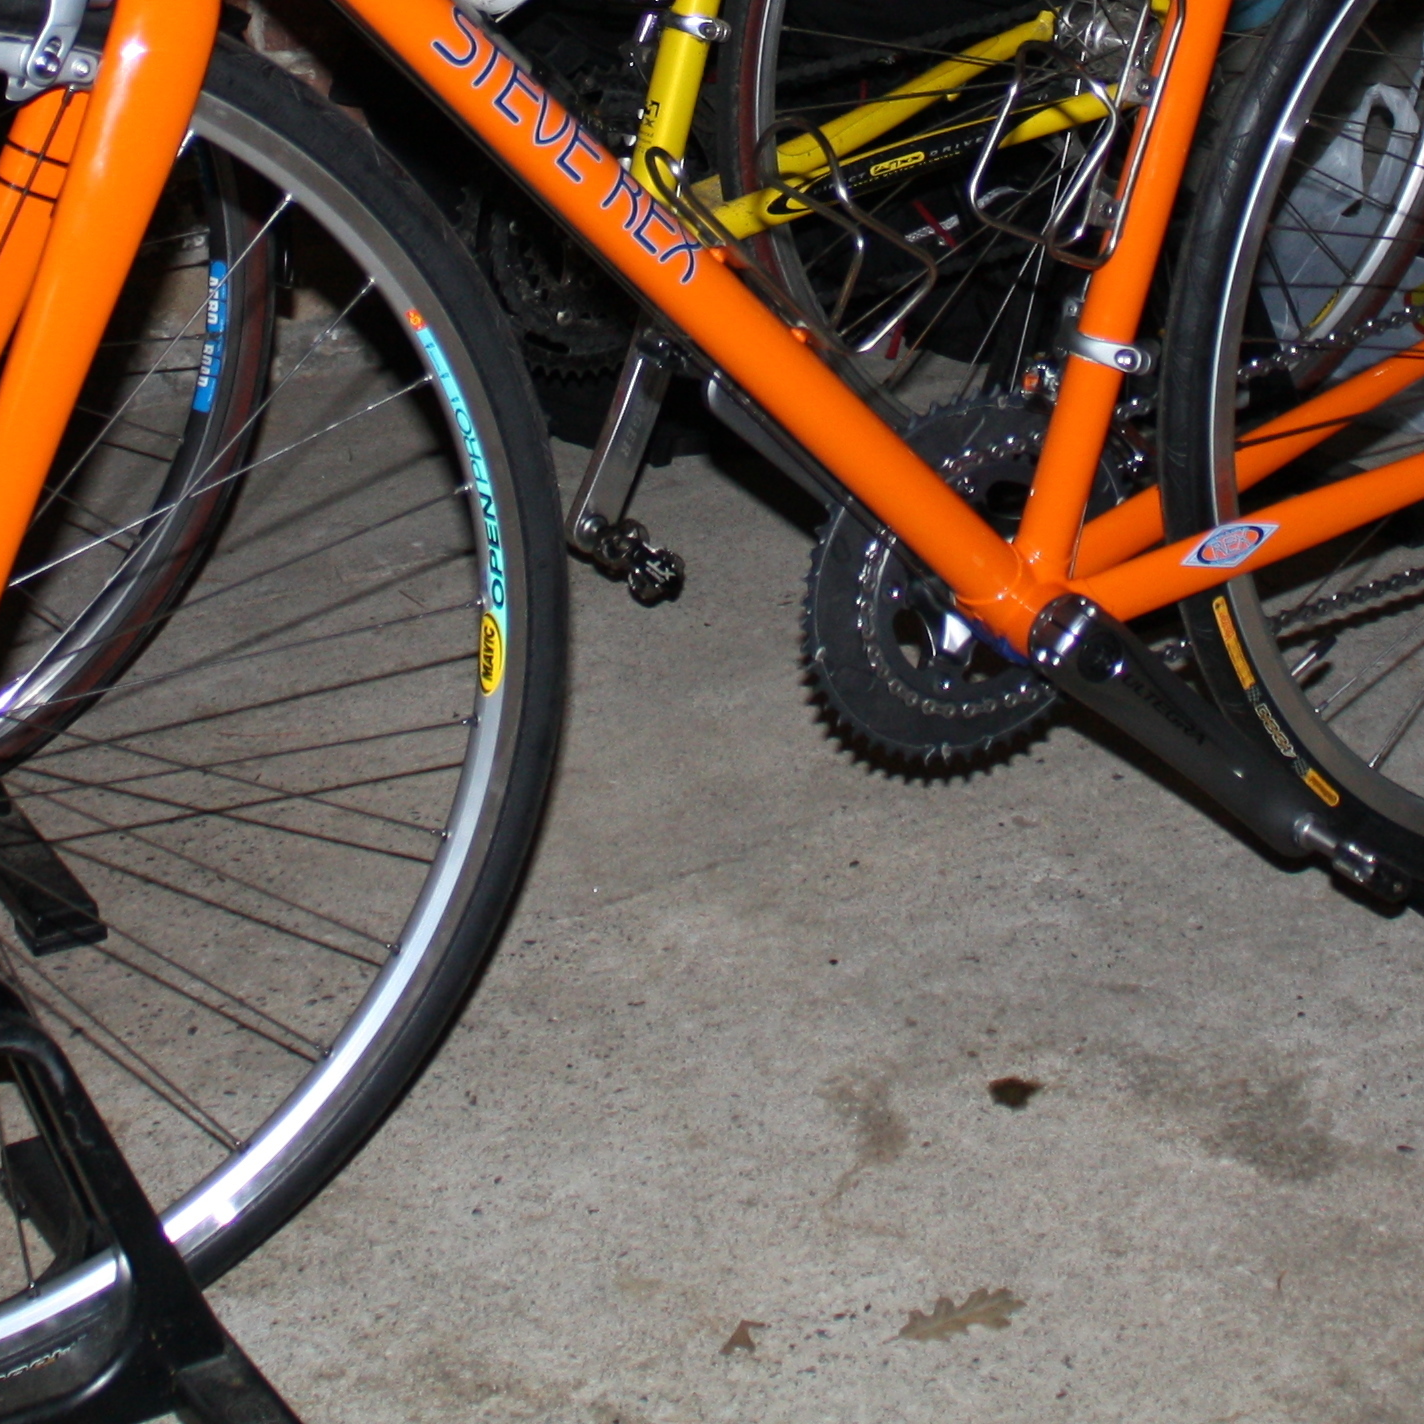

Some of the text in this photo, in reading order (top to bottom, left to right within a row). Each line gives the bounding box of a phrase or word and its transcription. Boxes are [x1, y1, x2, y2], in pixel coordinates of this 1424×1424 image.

[433, 6, 704, 284] STEVE REX
[929, 136, 984, 157] DRIVE
[481, 624, 496, 684] MAVIC
[1121, 674, 1208, 745] ULTEGRA
